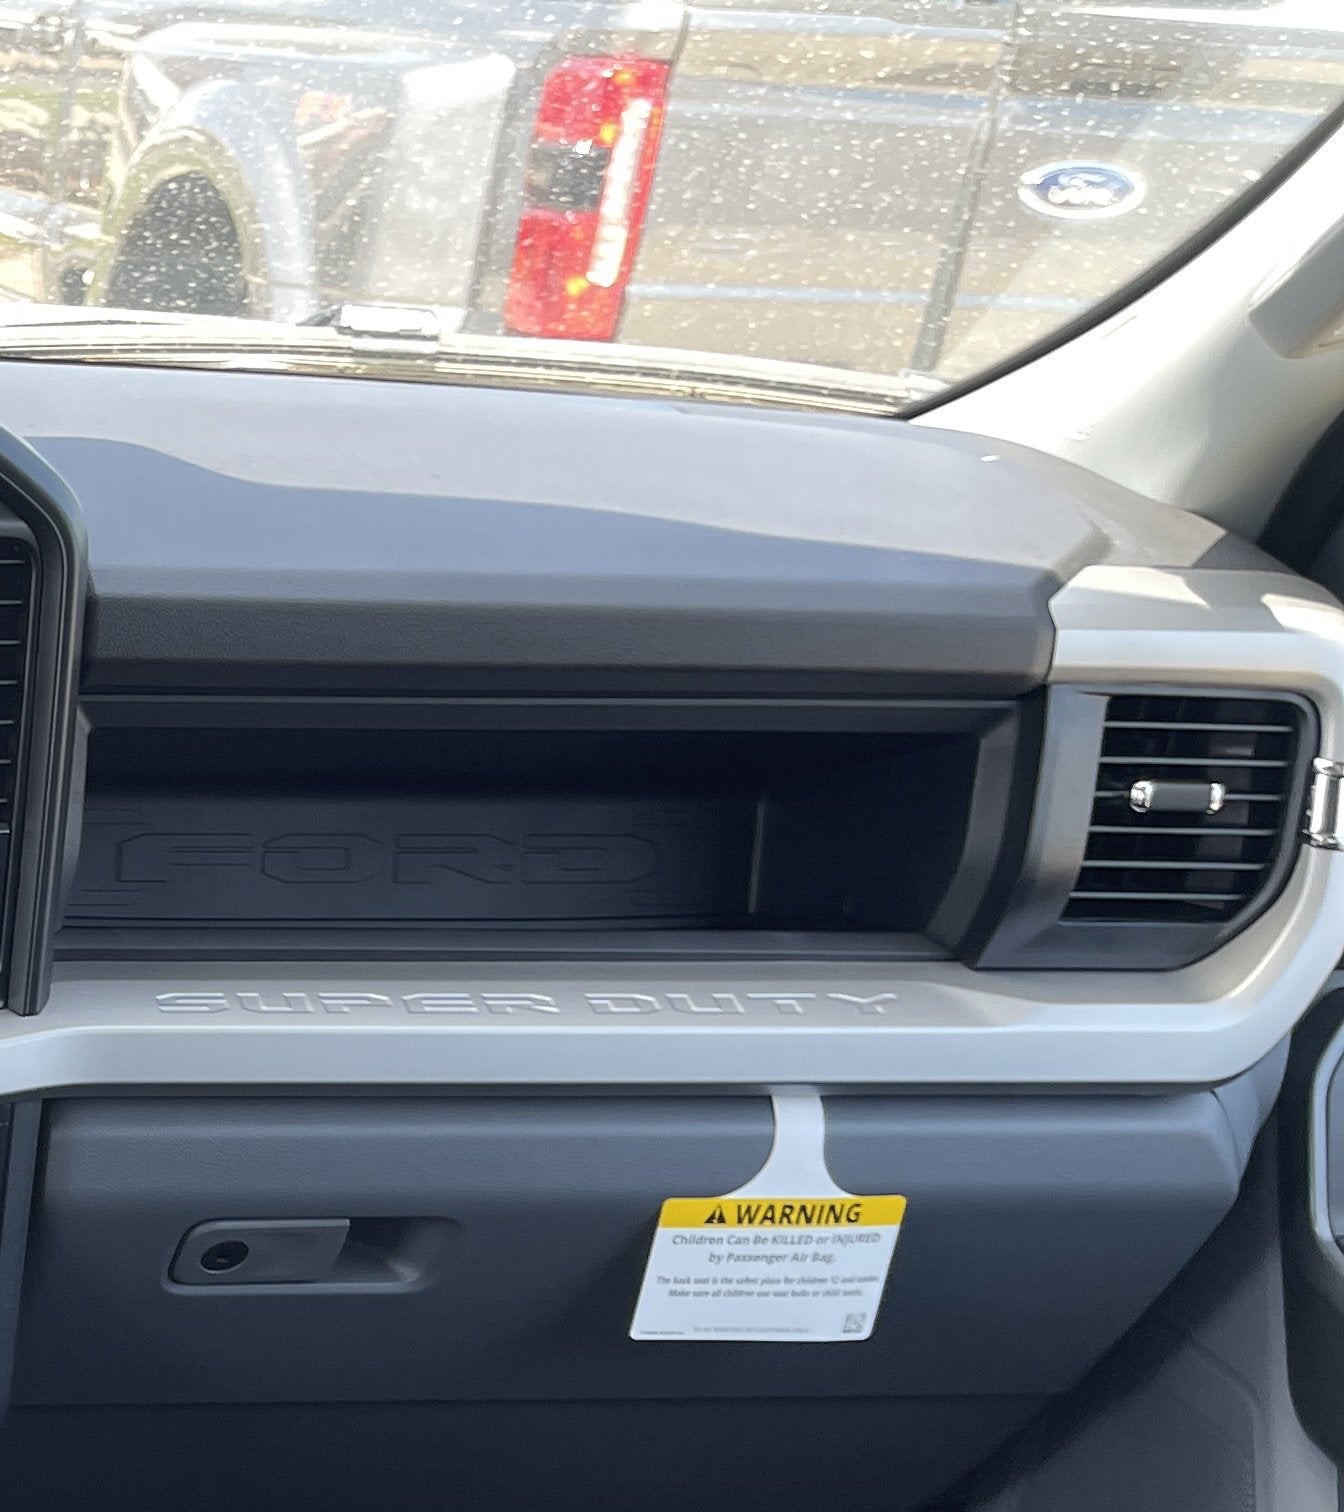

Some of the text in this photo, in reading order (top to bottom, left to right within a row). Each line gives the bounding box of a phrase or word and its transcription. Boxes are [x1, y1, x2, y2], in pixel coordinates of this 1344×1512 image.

[155, 991, 898, 1015] SUPER DUTY
[736, 1202, 863, 1225] WARNING
[672, 1232, 882, 1246] Children Can Be KILLED or INJURED
[708, 1252, 724, 1265] by
[726, 1252, 788, 1265] Passenger
[790, 1252, 809, 1263] Air
